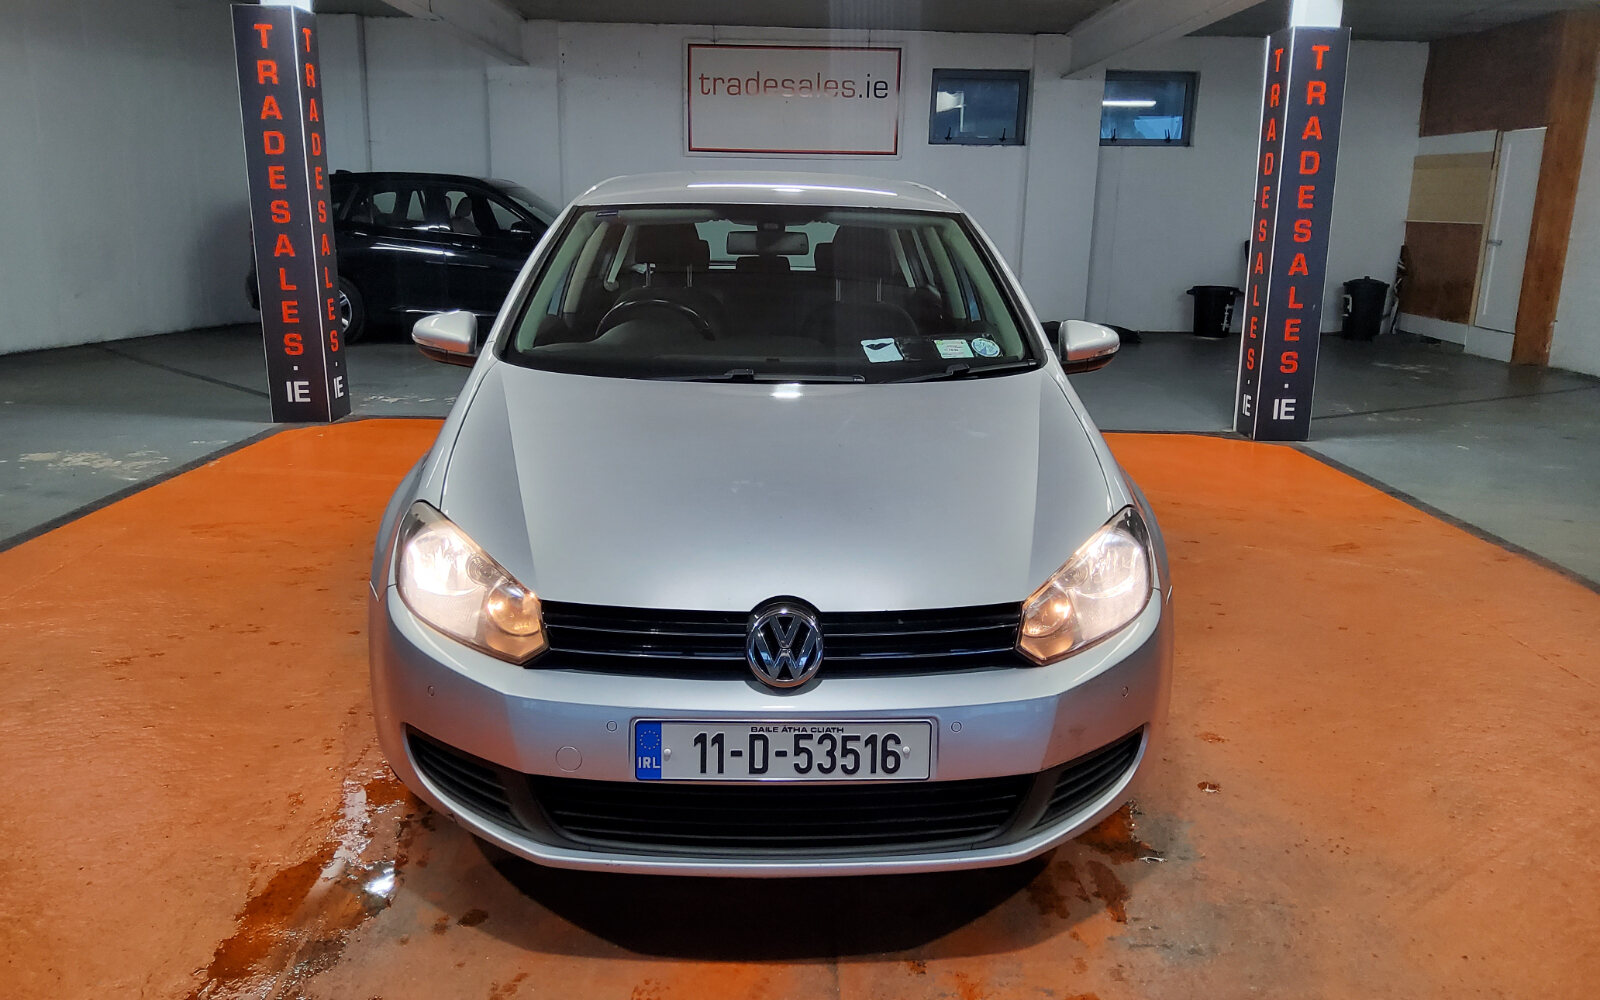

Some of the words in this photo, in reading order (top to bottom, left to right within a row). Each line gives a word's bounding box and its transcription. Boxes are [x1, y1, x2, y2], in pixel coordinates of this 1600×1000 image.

[699, 71, 888, 99] tradesales.ie
[753, 612, 818, 682] VW
[781, 725, 808, 733] ÁTHA
[638, 757, 661, 769] IRL
[693, 732, 901, 775] 11-D-53516
